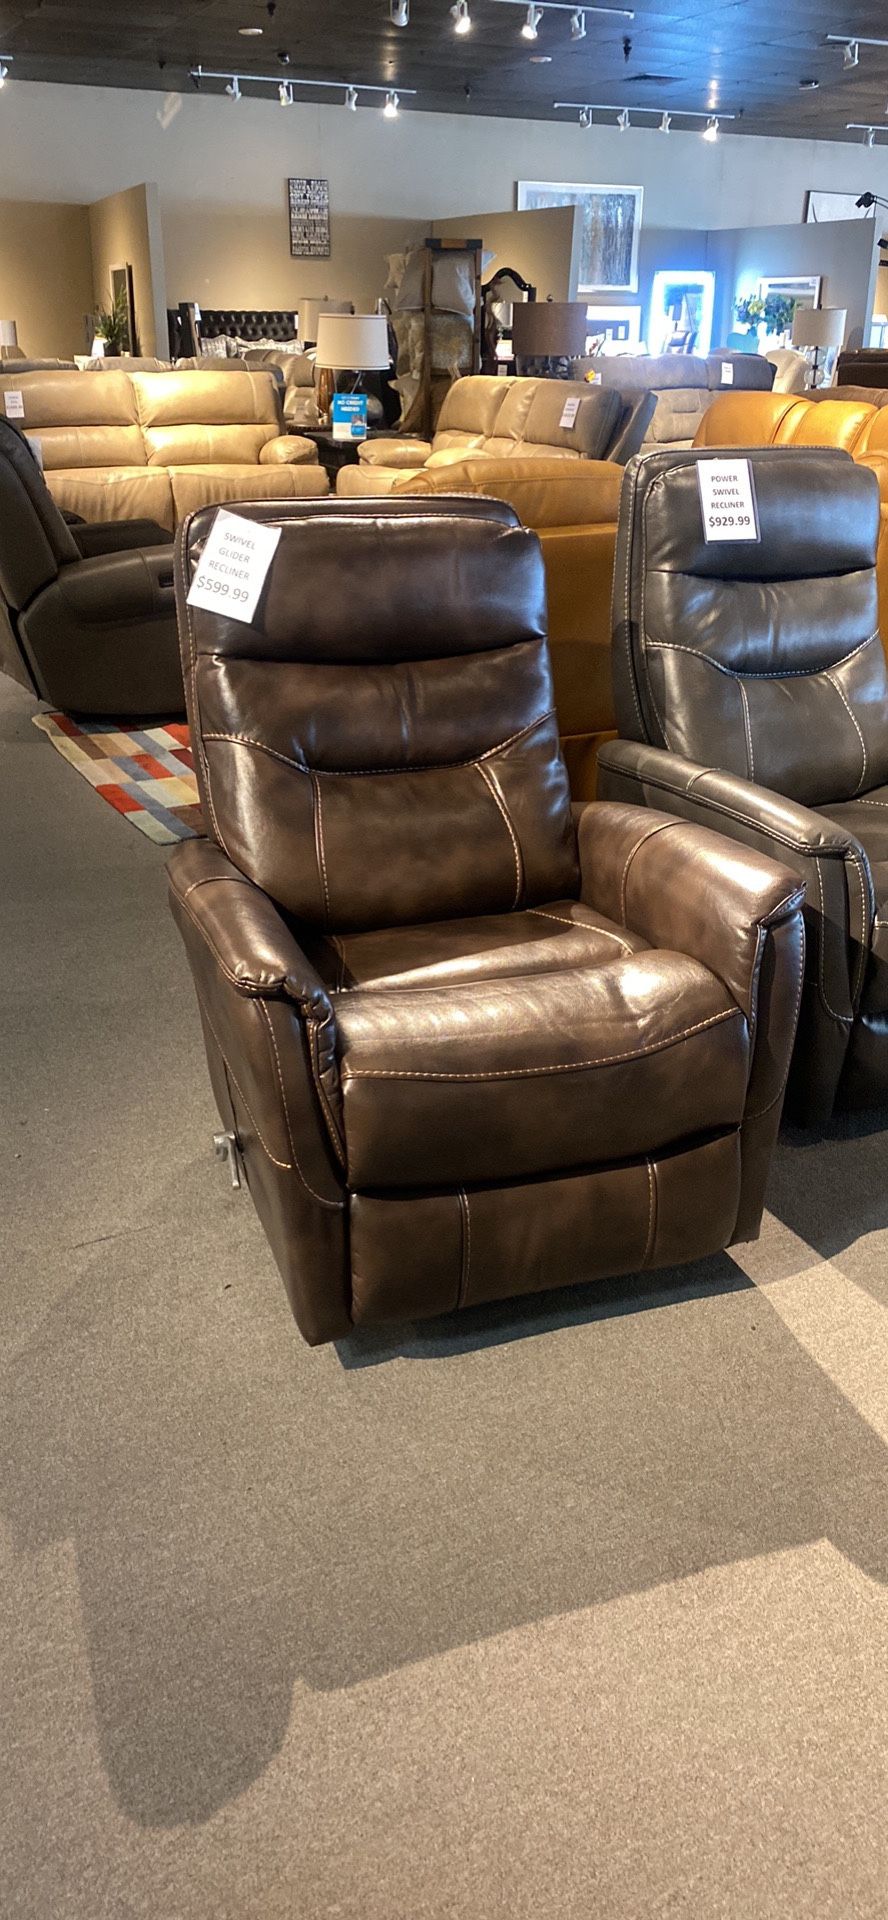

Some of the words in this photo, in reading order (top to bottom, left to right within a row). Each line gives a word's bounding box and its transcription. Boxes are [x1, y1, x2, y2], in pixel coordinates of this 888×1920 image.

[712, 488, 740, 496] SWIVEL
[711, 501, 744, 509] RECLINER
[708, 515, 750, 528] $929.99
[224, 532, 256, 550] SWIVEL
[218, 547, 251, 563] GLIDER
[208, 560, 250, 580] RECLINER
[196, 575, 250, 603] $599.99
